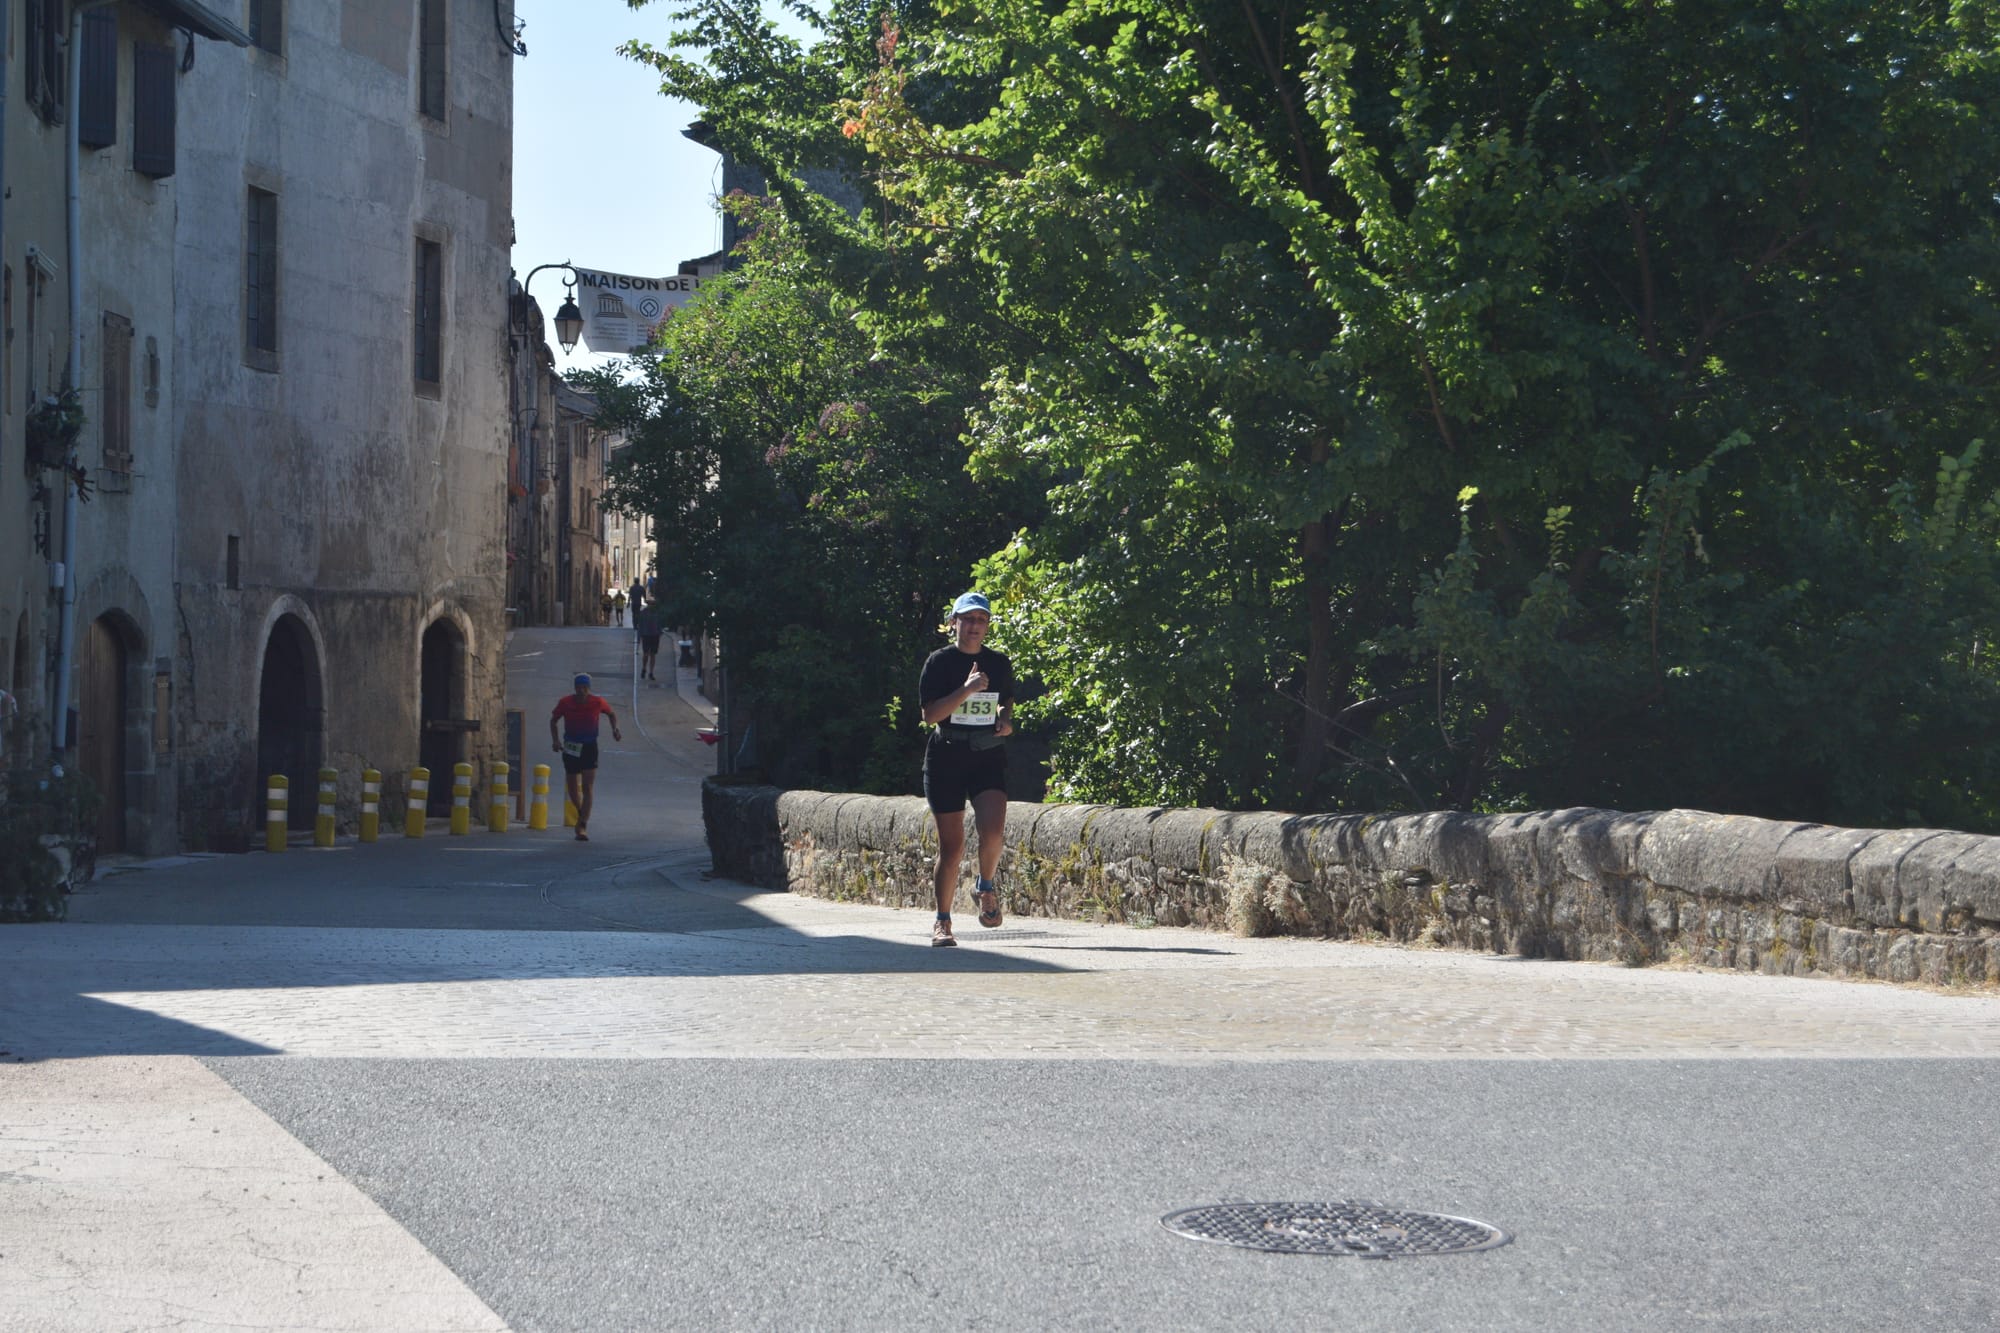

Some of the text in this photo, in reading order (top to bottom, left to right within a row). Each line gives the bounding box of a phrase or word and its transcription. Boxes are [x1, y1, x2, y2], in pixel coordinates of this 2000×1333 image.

[582, 273, 659, 291] MAISON
[665, 278, 690, 291] DE
[960, 701, 991, 714] 153
